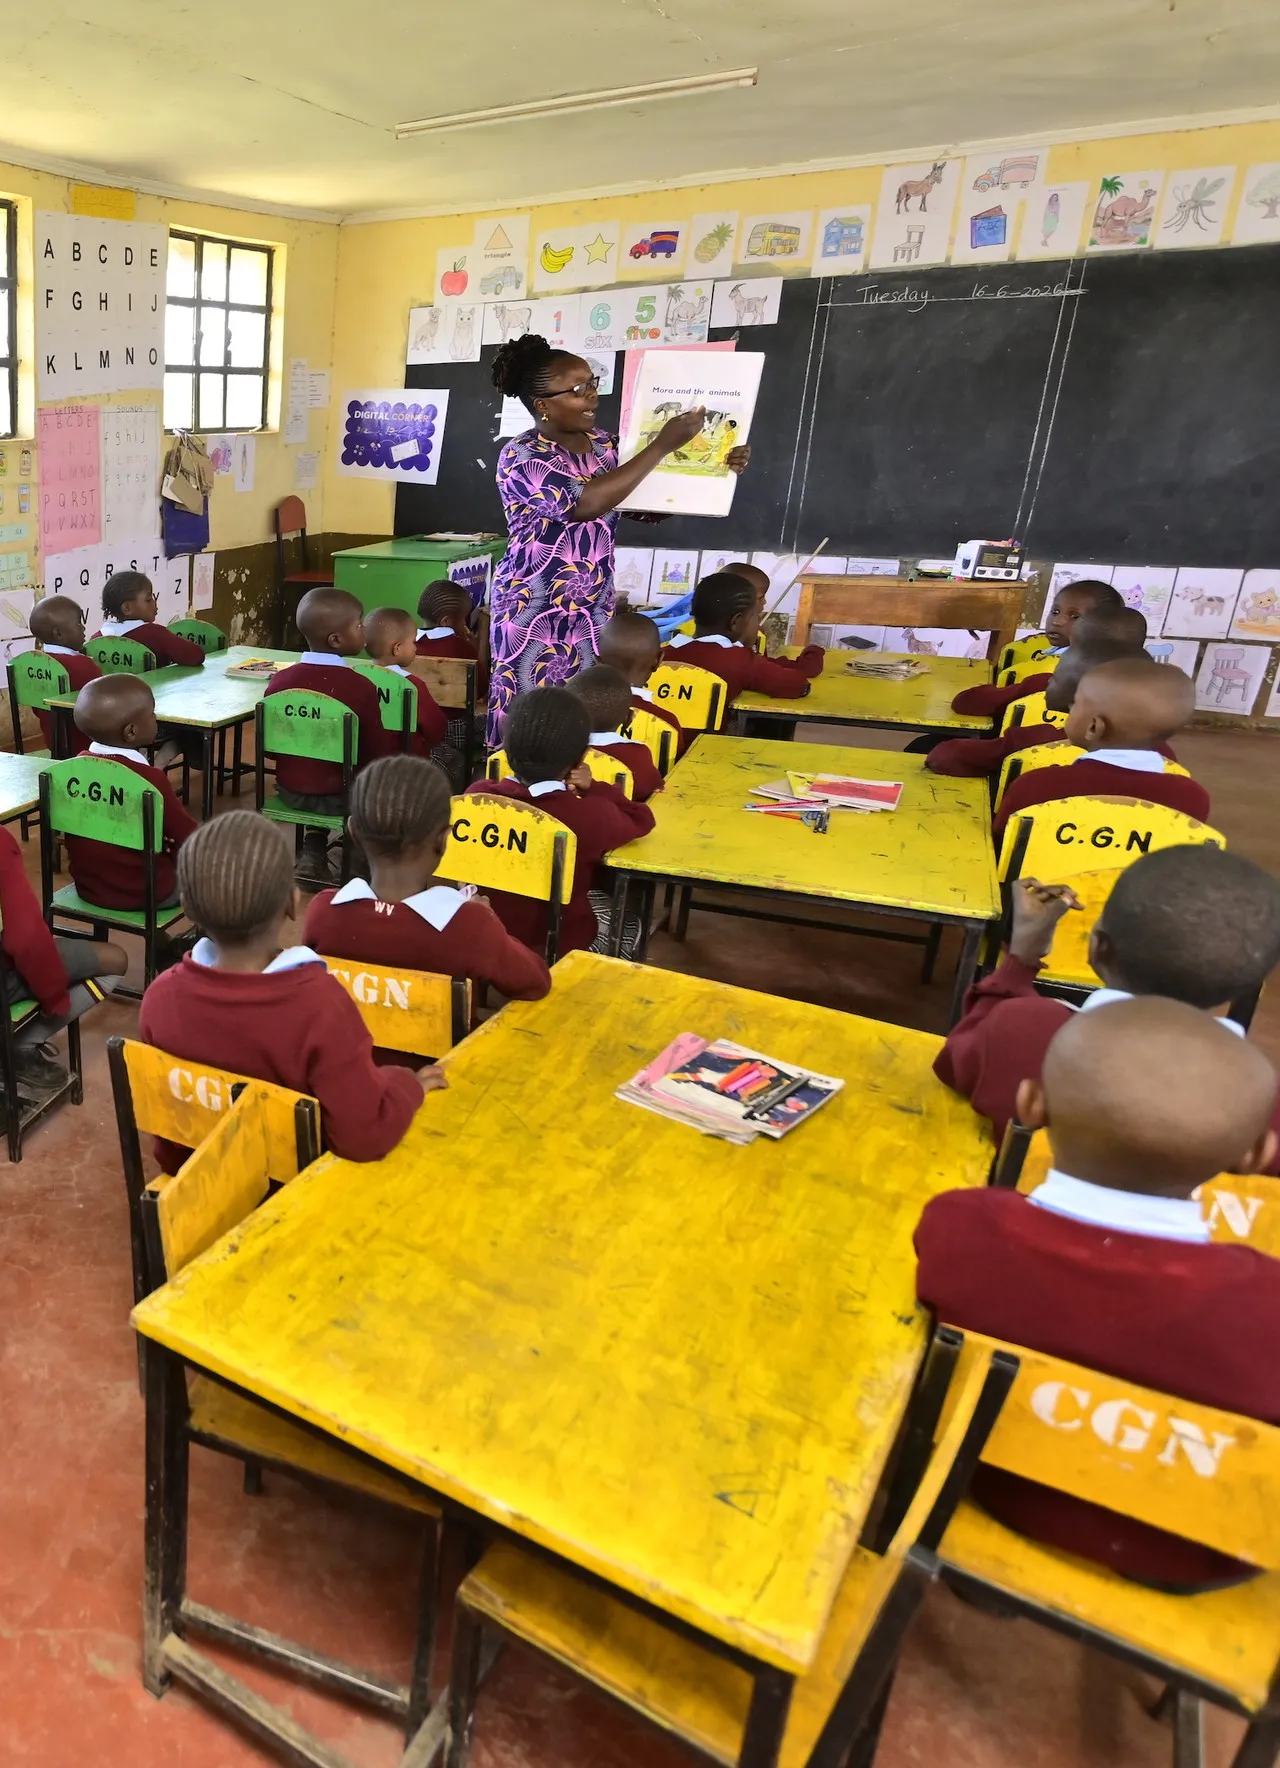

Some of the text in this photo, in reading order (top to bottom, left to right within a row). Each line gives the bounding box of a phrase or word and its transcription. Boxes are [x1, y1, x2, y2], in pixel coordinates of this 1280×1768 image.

[44, 239, 158, 267] A B C D E
[46, 289, 157, 312] F G H I J
[971, 282, 1066, 299] 16-6-2026
[590, 302, 612, 332] 6
[635, 295, 657, 324] 5
[553, 311, 563, 333] 1
[624, 325, 662, 341] five
[584, 331, 613, 350] six
[46, 347, 158, 374] K L M N O
[652, 386, 674, 395] Mora
[675, 388, 692, 396] and
[708, 389, 741, 397] animals
[353, 410, 430, 423] DIGITAL CORNER
[44, 488, 96, 509] P Q R S T
[54, 577, 63, 593] P
[79, 568, 90, 586] Q
[105, 563, 114, 580] R
[152, 556, 160, 572] T
[174, 578, 182, 595] Z
[98, 650, 133, 668] C.G.N
[27, 666, 52, 681] C.G.N
[284, 703, 321, 720] C.G.N
[66, 777, 124, 807] C.G.N
[451, 818, 528, 854] C.G.N
[1055, 822, 1153, 853] C.G.N
[167, 1067, 235, 1112] CG
[1029, 1380, 1237, 1479] CGN
